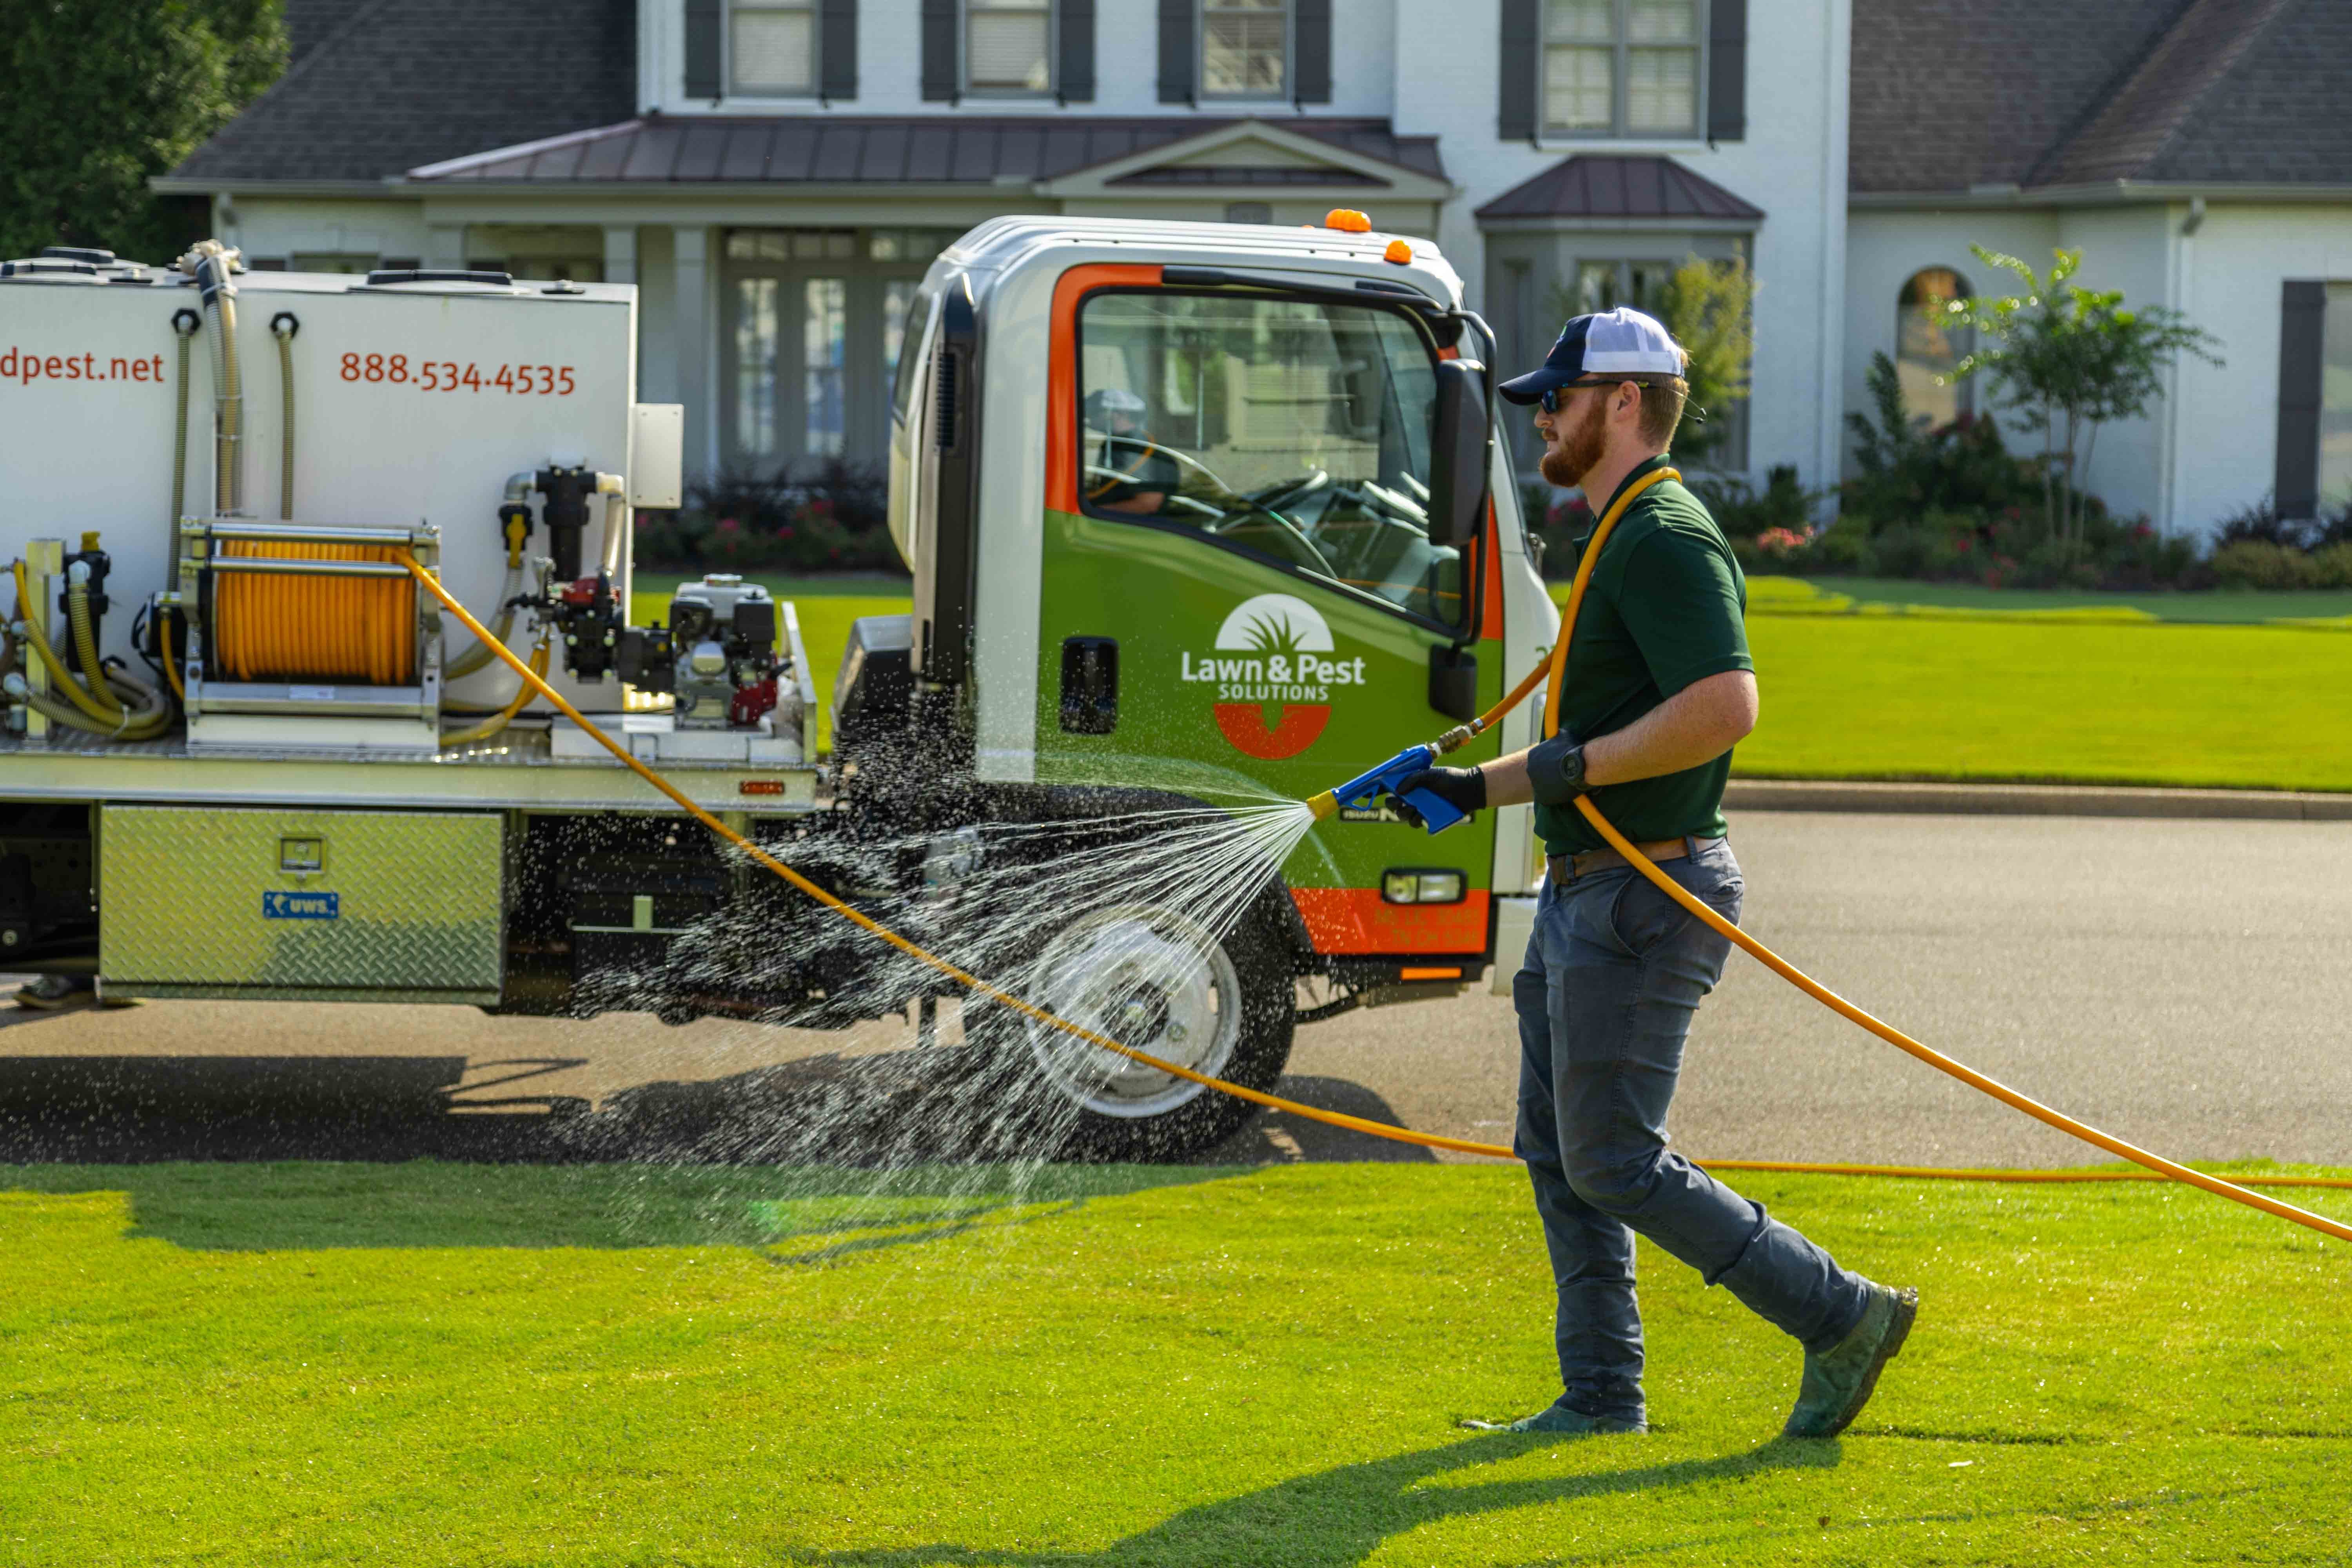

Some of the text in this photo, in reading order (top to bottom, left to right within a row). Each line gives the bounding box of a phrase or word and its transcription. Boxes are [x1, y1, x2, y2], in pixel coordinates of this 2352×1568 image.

[0, 347, 164, 385] dpest.net
[340, 352, 575, 396] 888.534.4535
[1181, 651, 1366, 685] Lawn & Pest
[1218, 683, 1329, 701] SOLUTIONS
[290, 899, 328, 913] UWS
